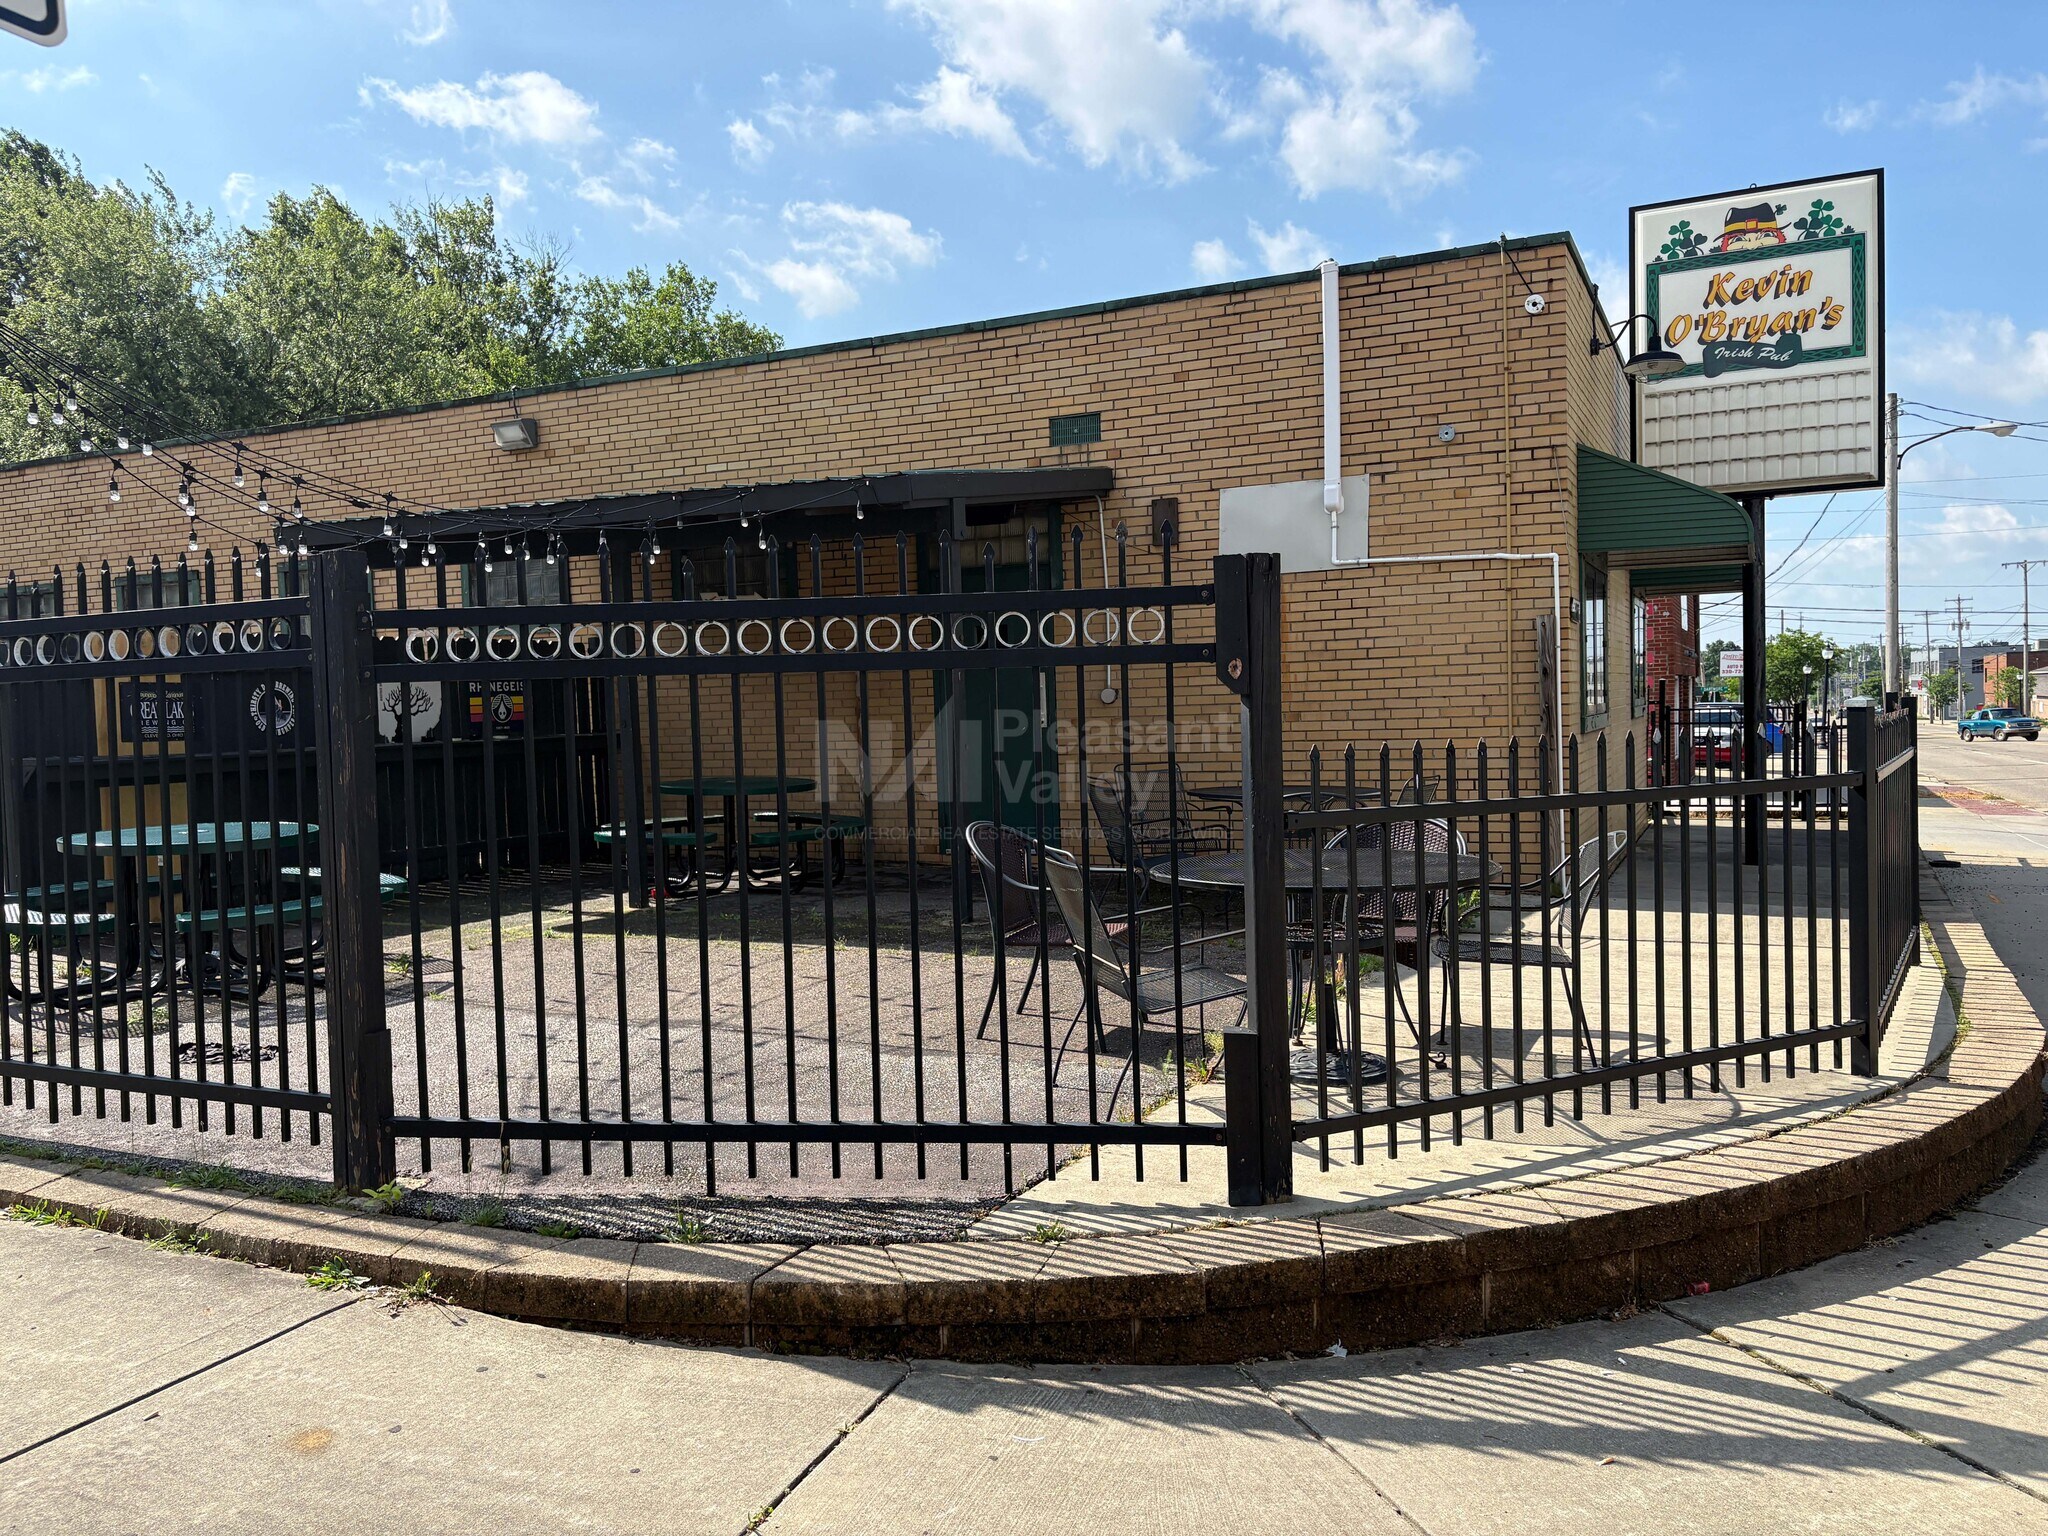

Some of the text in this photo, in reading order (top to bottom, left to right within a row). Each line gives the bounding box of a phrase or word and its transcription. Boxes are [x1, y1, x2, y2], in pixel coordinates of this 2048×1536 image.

[1703, 264, 1813, 309] Kevin
[1665, 296, 1845, 348] O'Bryan's
[1714, 345, 1795, 361] Irish Pub
[250, 687, 262, 717] THIRSTY
